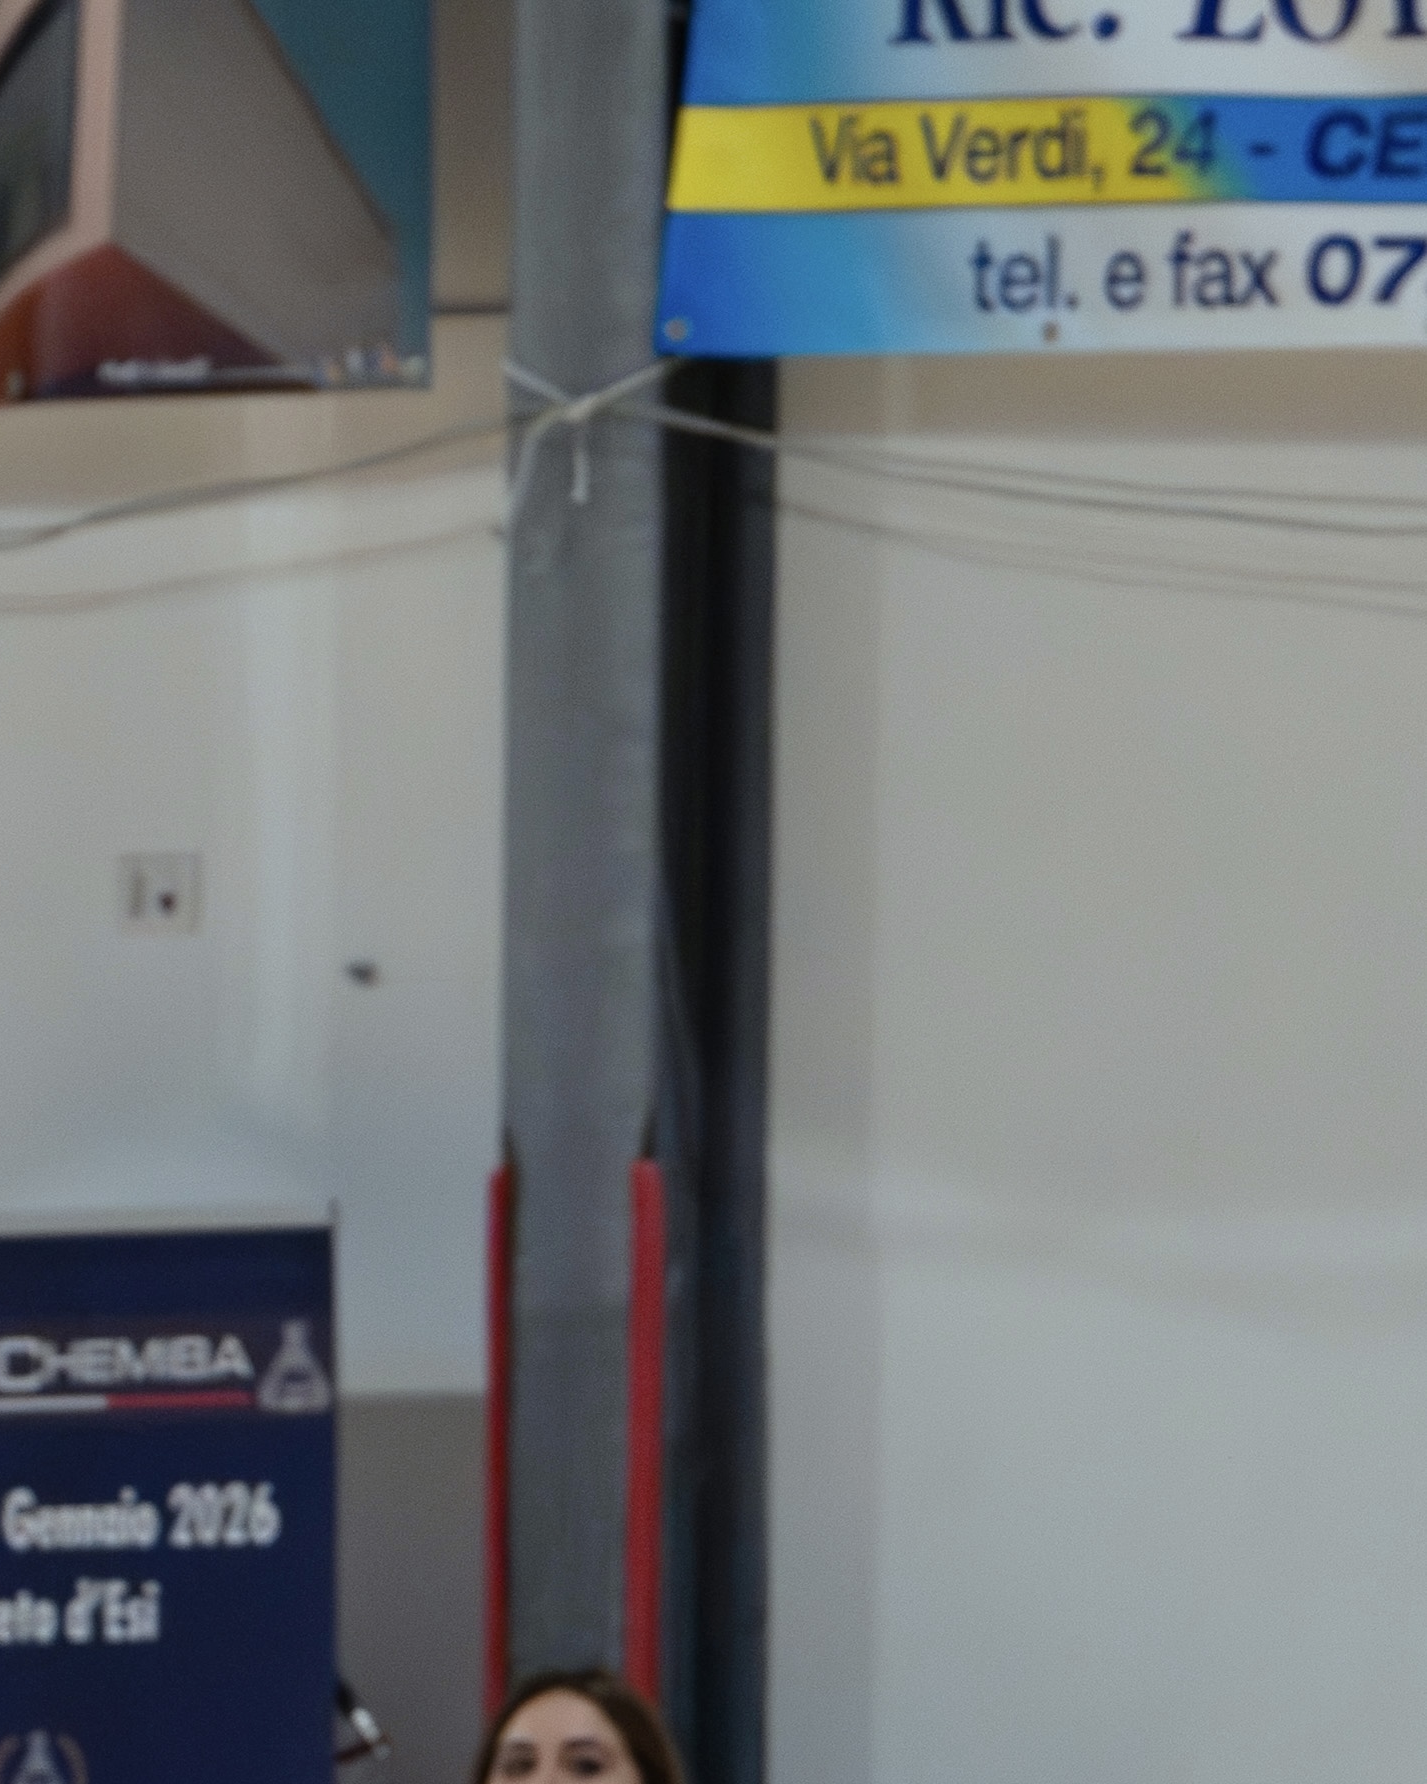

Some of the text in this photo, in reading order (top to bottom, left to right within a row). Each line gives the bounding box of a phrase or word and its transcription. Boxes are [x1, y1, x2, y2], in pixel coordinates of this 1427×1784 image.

[808, 107, 1427, 192] Via Verdi, 24 - CE
[968, 229, 1427, 313] tel. e fax 07
[165, 1481, 282, 1548] 2026
